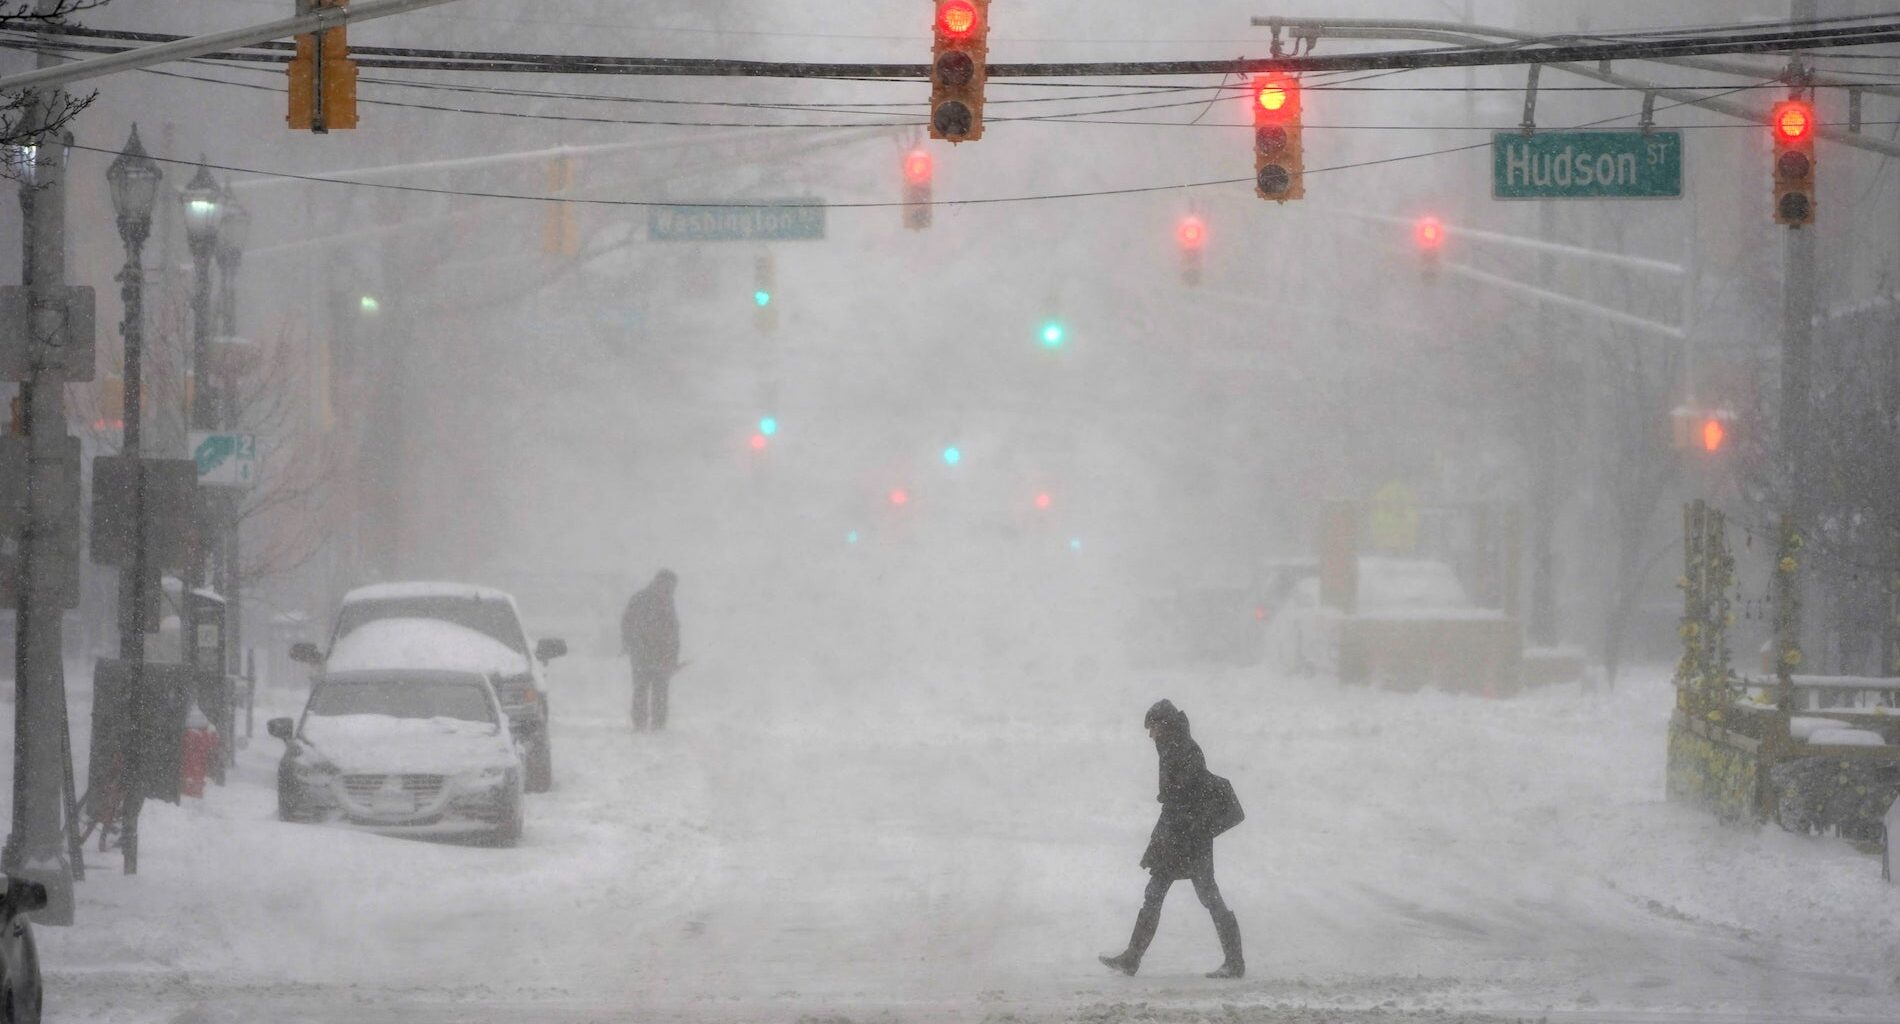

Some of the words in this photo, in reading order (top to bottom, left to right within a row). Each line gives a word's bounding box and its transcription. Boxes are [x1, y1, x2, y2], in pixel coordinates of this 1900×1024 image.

[1507, 144, 1636, 186] Hudson
[1646, 143, 1667, 165] ST
[657, 208, 792, 235] Washington
